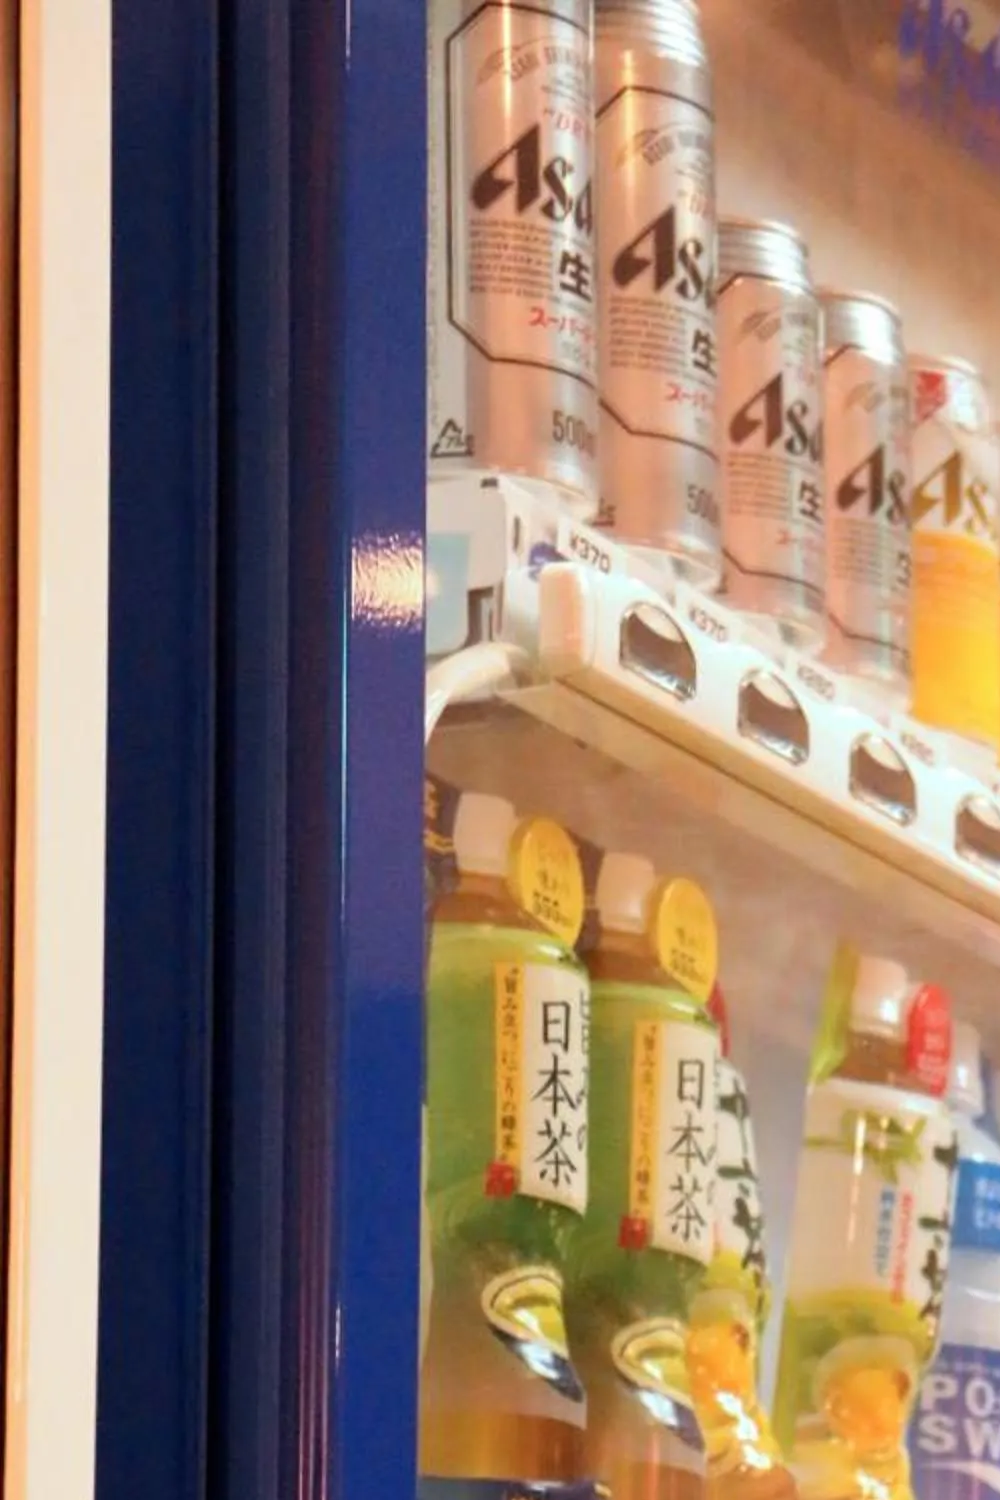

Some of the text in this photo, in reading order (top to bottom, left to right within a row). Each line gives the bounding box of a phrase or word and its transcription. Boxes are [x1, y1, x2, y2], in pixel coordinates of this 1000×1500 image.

[568, 533, 613, 575] ¥370
[530, 1000, 579, 1188] 日本茶
[668, 1057, 708, 1243] 日本茶
